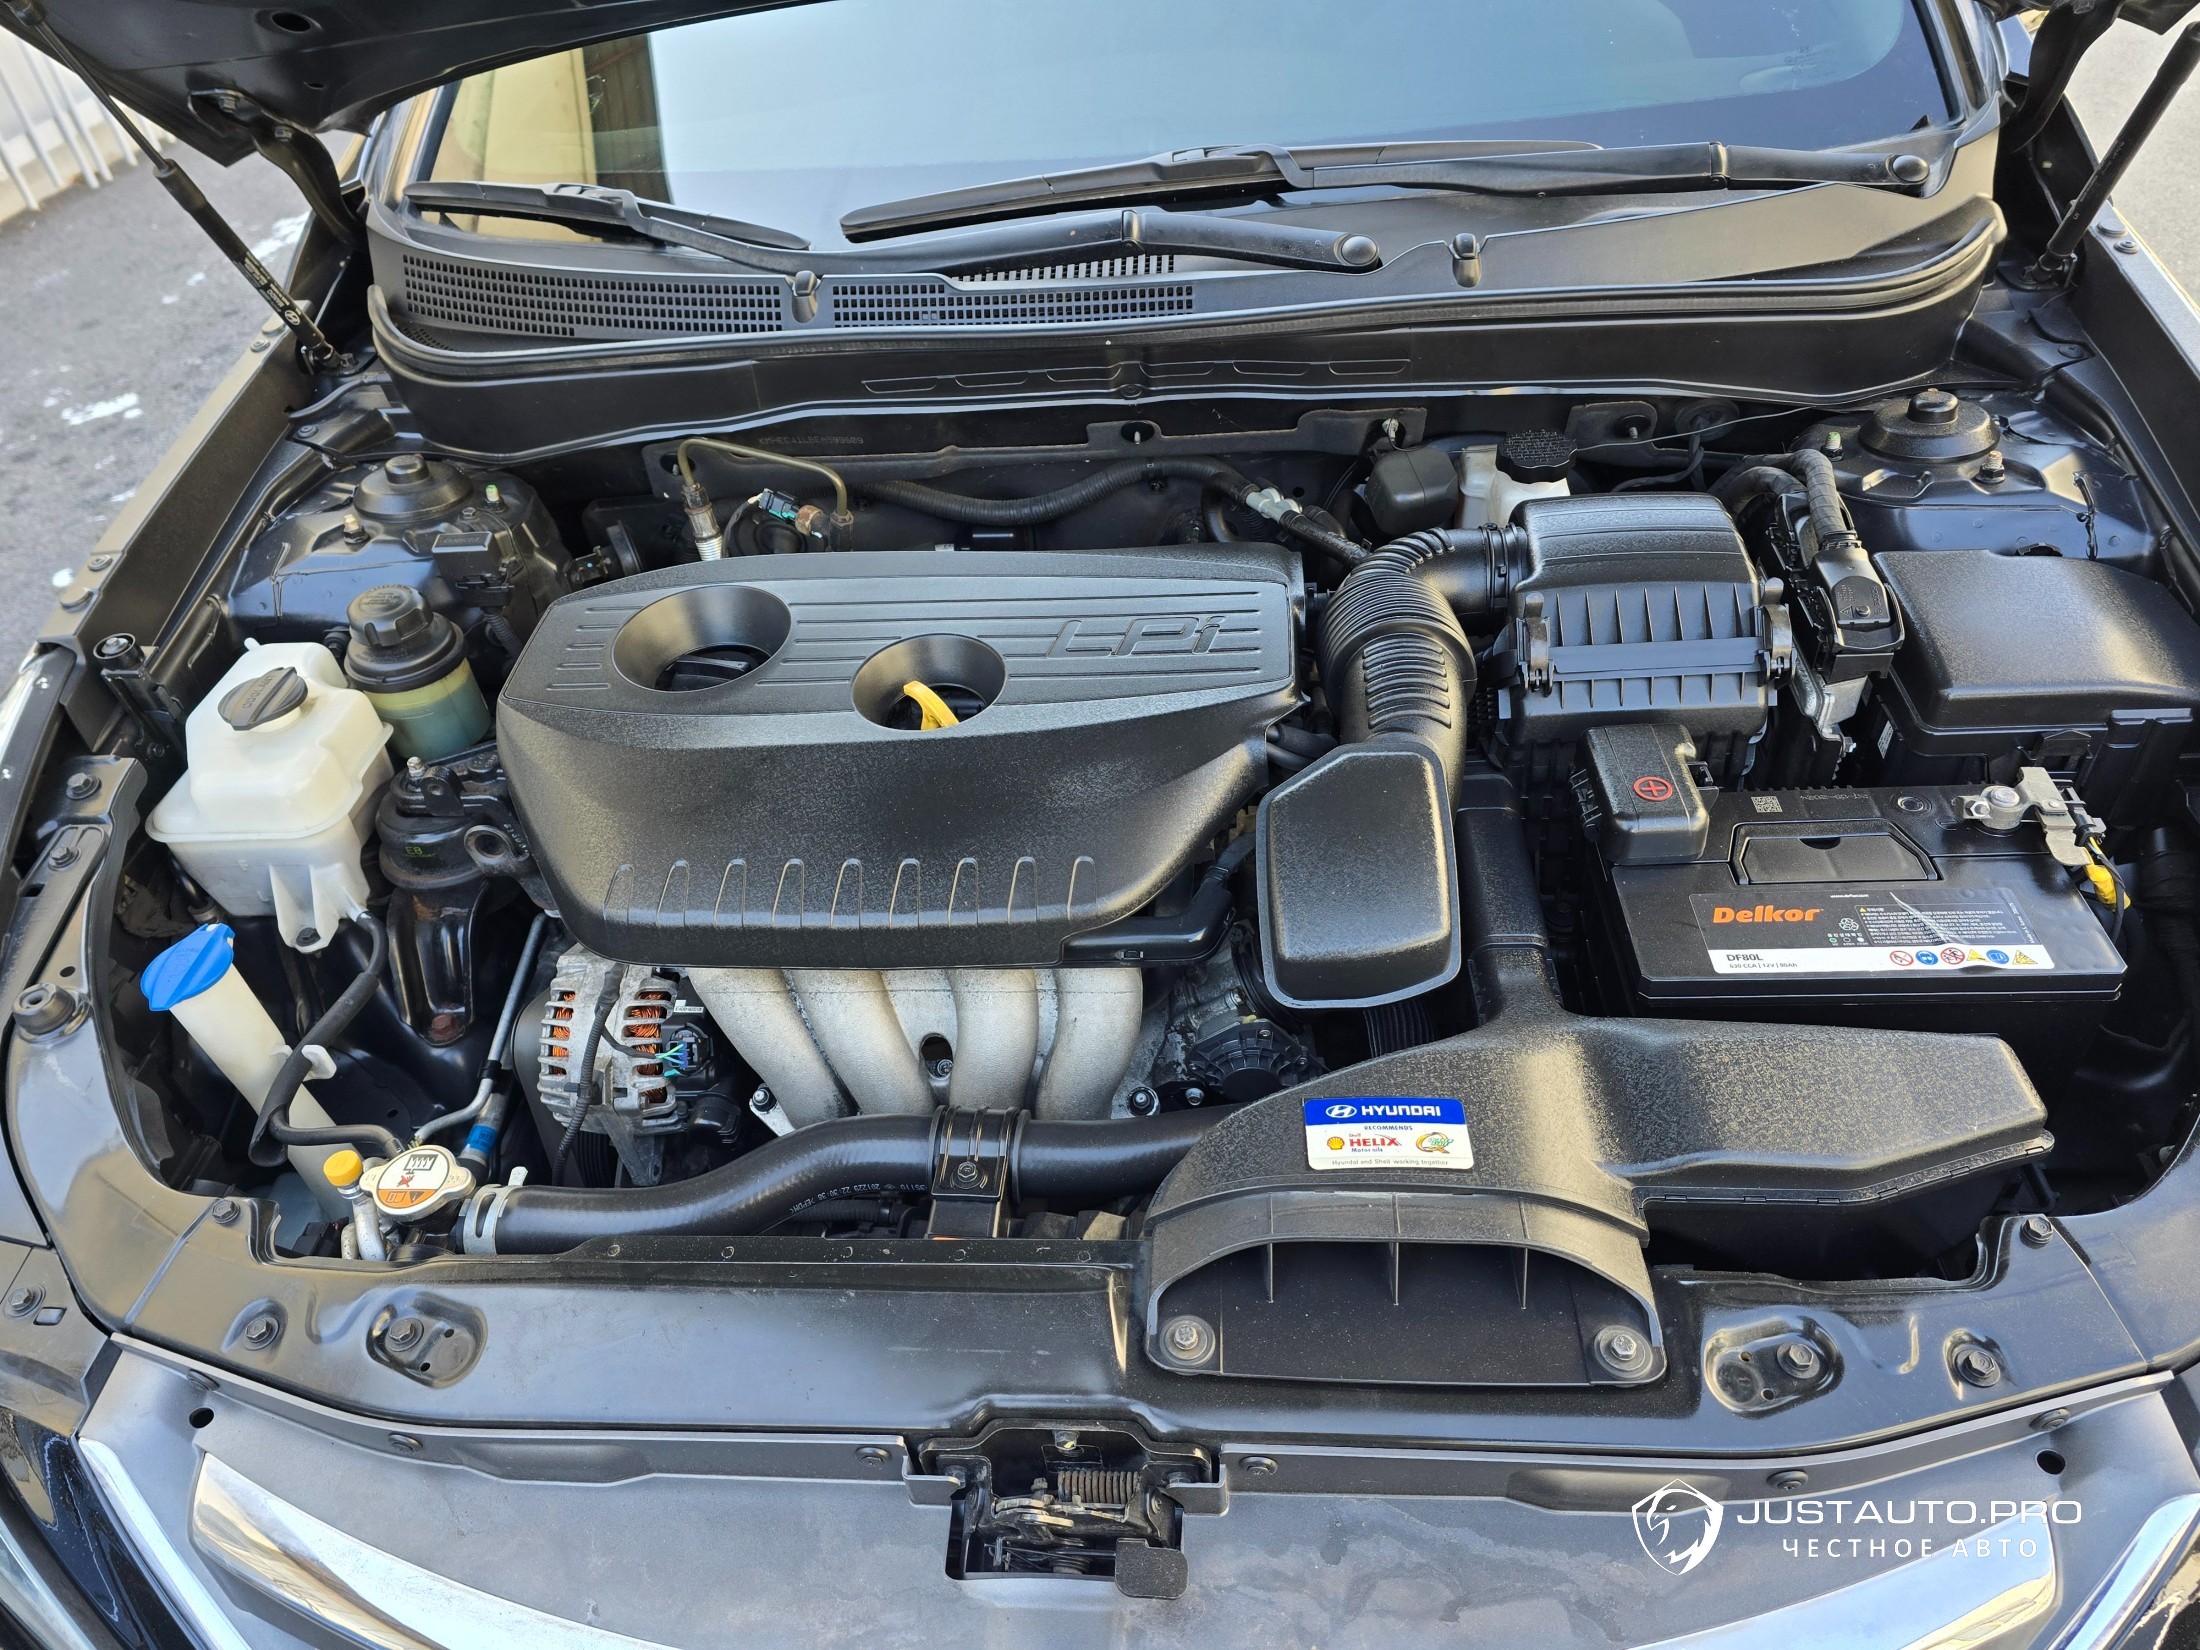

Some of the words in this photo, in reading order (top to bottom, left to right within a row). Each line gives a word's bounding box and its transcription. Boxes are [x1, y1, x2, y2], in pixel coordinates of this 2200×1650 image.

[1044, 614, 1228, 659] LPi
[242, 675, 276, 709] COOLANT
[404, 845, 424, 857] E8
[1713, 904, 1820, 923] Delkor
[1726, 953, 1764, 962] DF80L
[1361, 1105, 1441, 1117] HYUNDAI
[1349, 1138, 1401, 1147] HELIX
[1393, 1158, 1419, 1166] working
